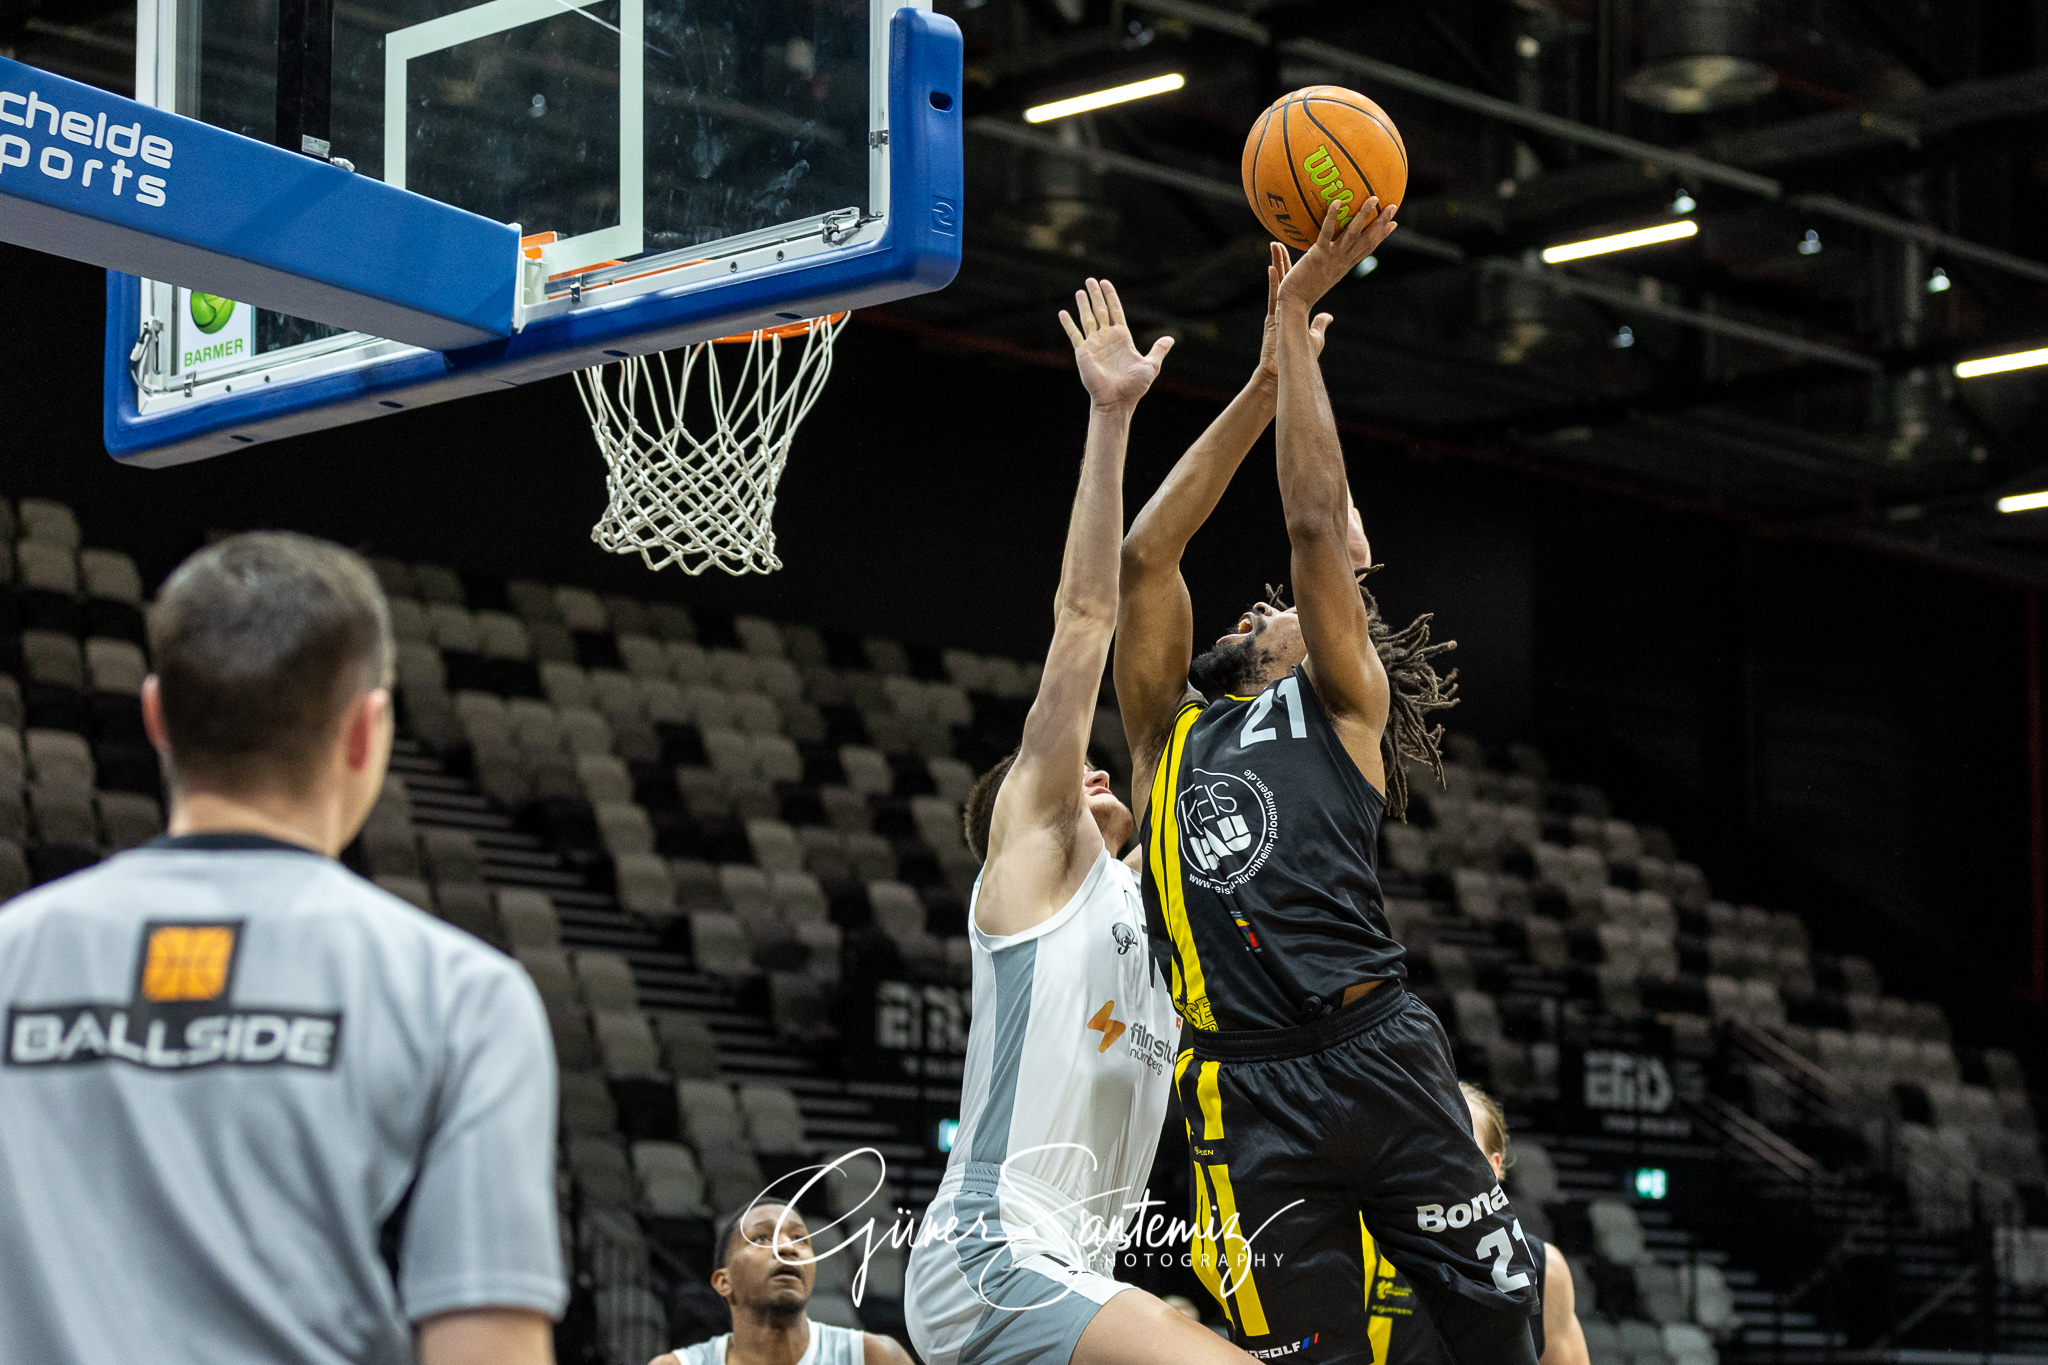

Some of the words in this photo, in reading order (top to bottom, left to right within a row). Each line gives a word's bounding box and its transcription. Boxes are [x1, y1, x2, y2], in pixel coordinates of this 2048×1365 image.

[184, 338, 243, 367] BARMER
[1240, 676, 1307, 749] 21
[11, 1011, 337, 1068] BALLSIDE
[1245, 1340, 1301, 1360] OSOLF
